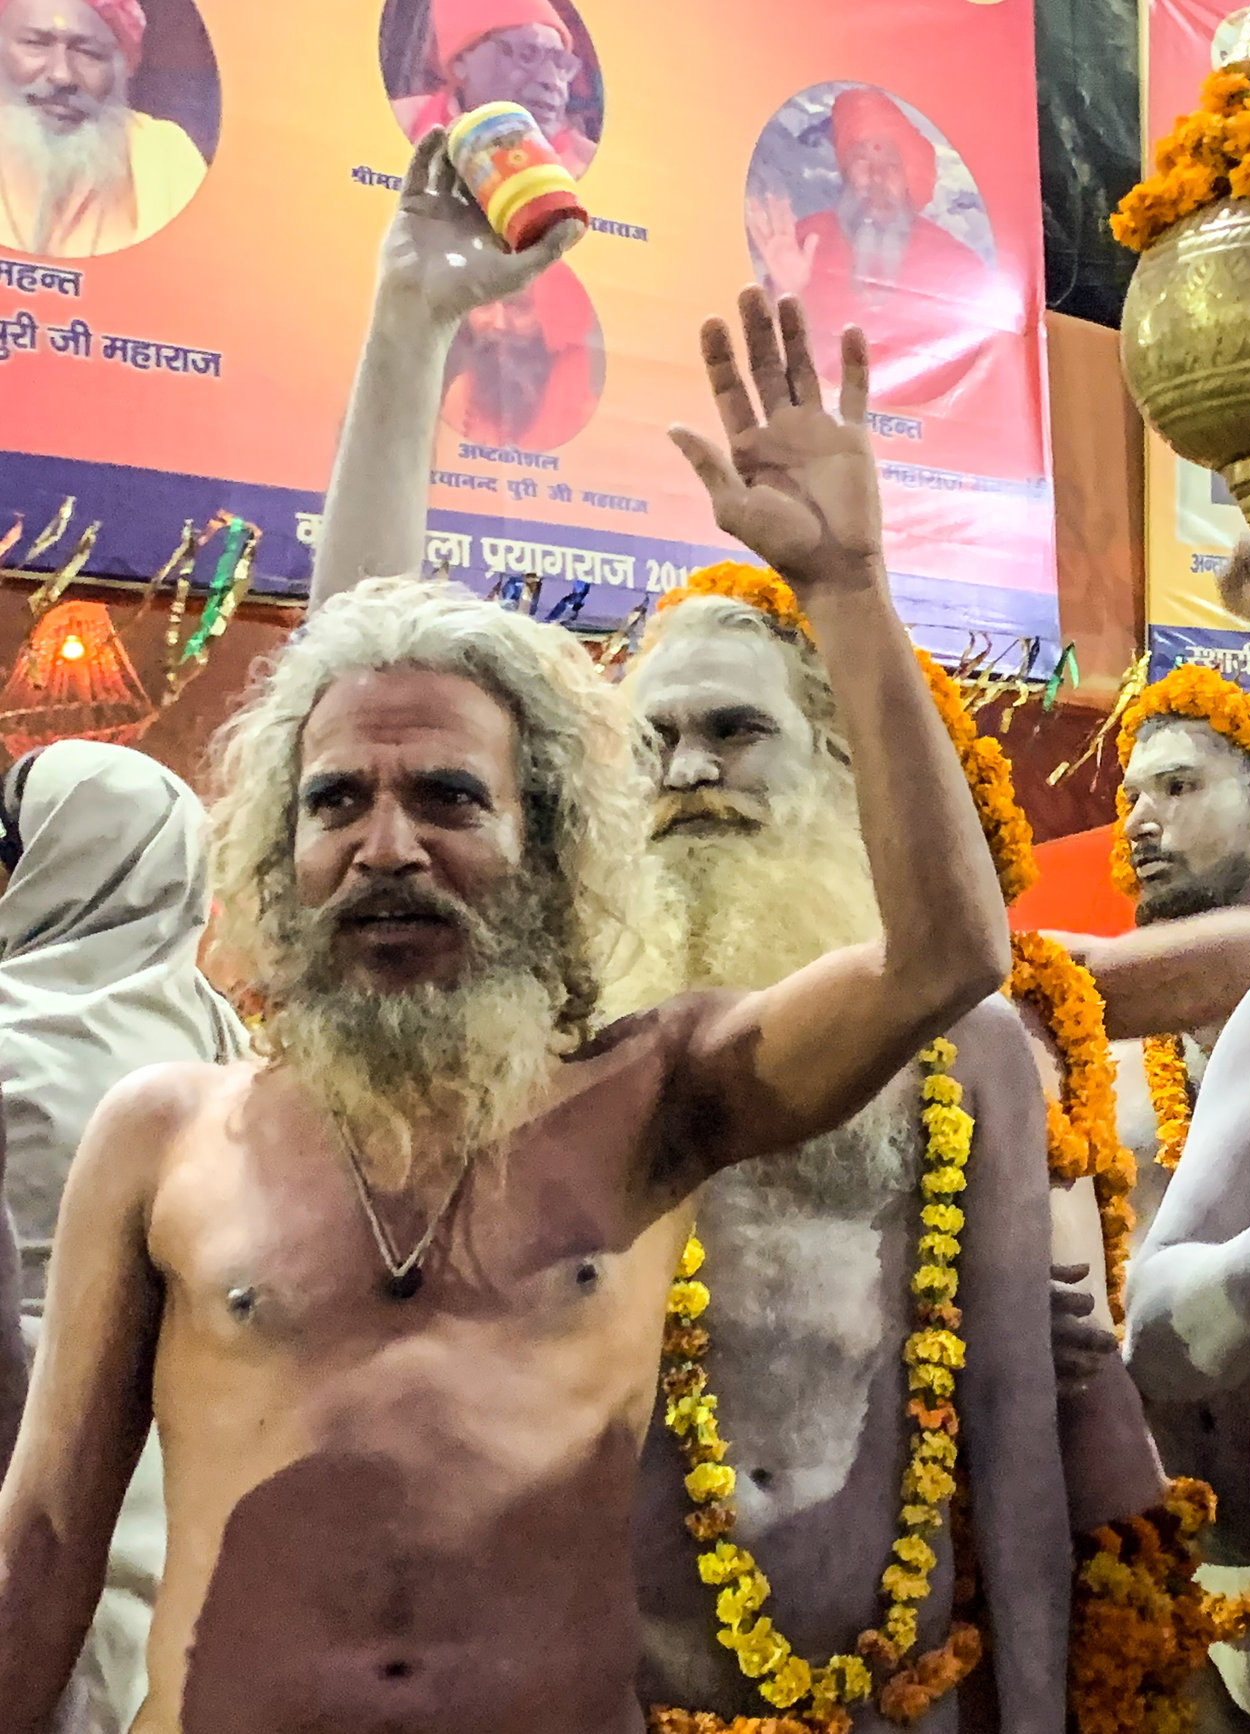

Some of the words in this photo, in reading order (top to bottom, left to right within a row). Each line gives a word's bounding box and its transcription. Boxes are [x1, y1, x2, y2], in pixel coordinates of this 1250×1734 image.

[47, 319, 92, 356] जी
[101, 335, 222, 376] महाराज
[507, 478, 537, 500] पुरी
[581, 490, 648, 513] महाराज
[427, 530, 472, 568] ला
[480, 536, 636, 588] प्रयागराज
[646, 559, 702, 594] 201
